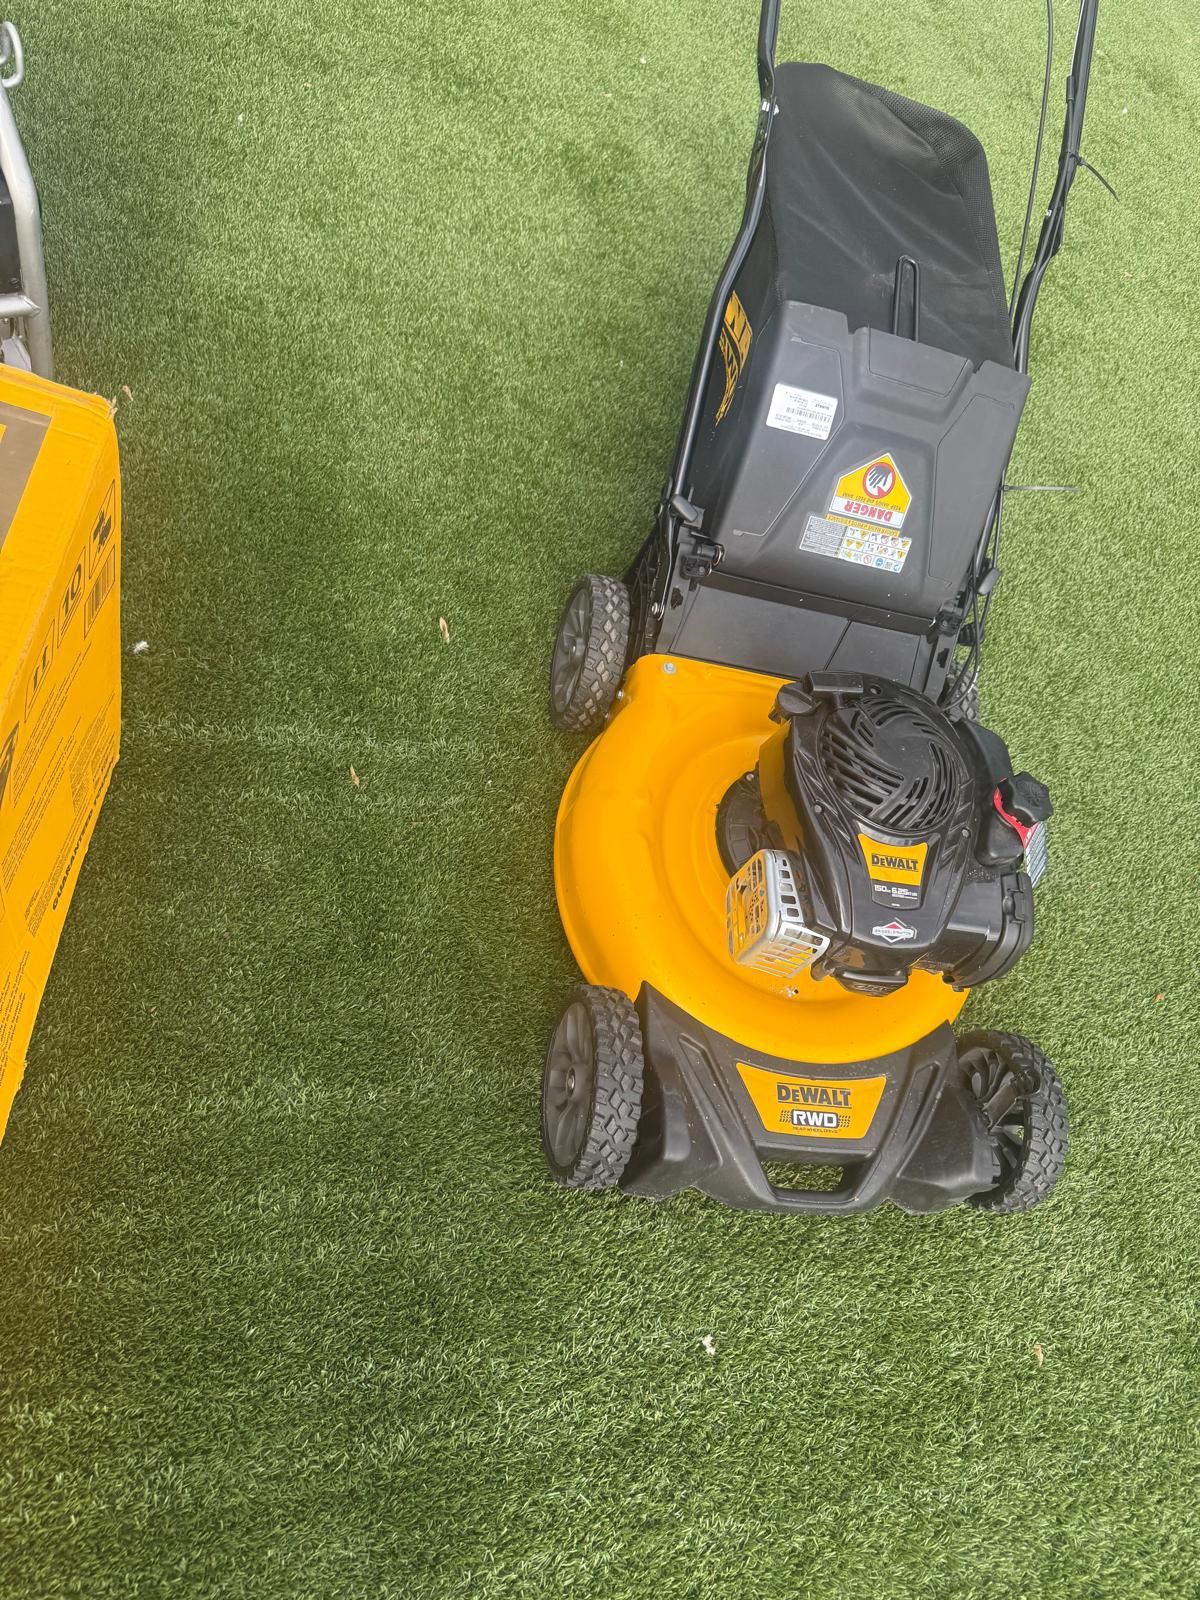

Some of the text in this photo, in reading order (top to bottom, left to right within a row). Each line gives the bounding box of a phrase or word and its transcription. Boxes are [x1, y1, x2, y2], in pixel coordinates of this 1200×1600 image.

[844, 500, 894, 522] DANGER
[62, 564, 82, 618] 10
[52, 808, 93, 911] GUARANTEED
[872, 854, 919, 871] DEWALT
[777, 1084, 851, 1106] DEWALT
[793, 1110, 837, 1128] RWD
